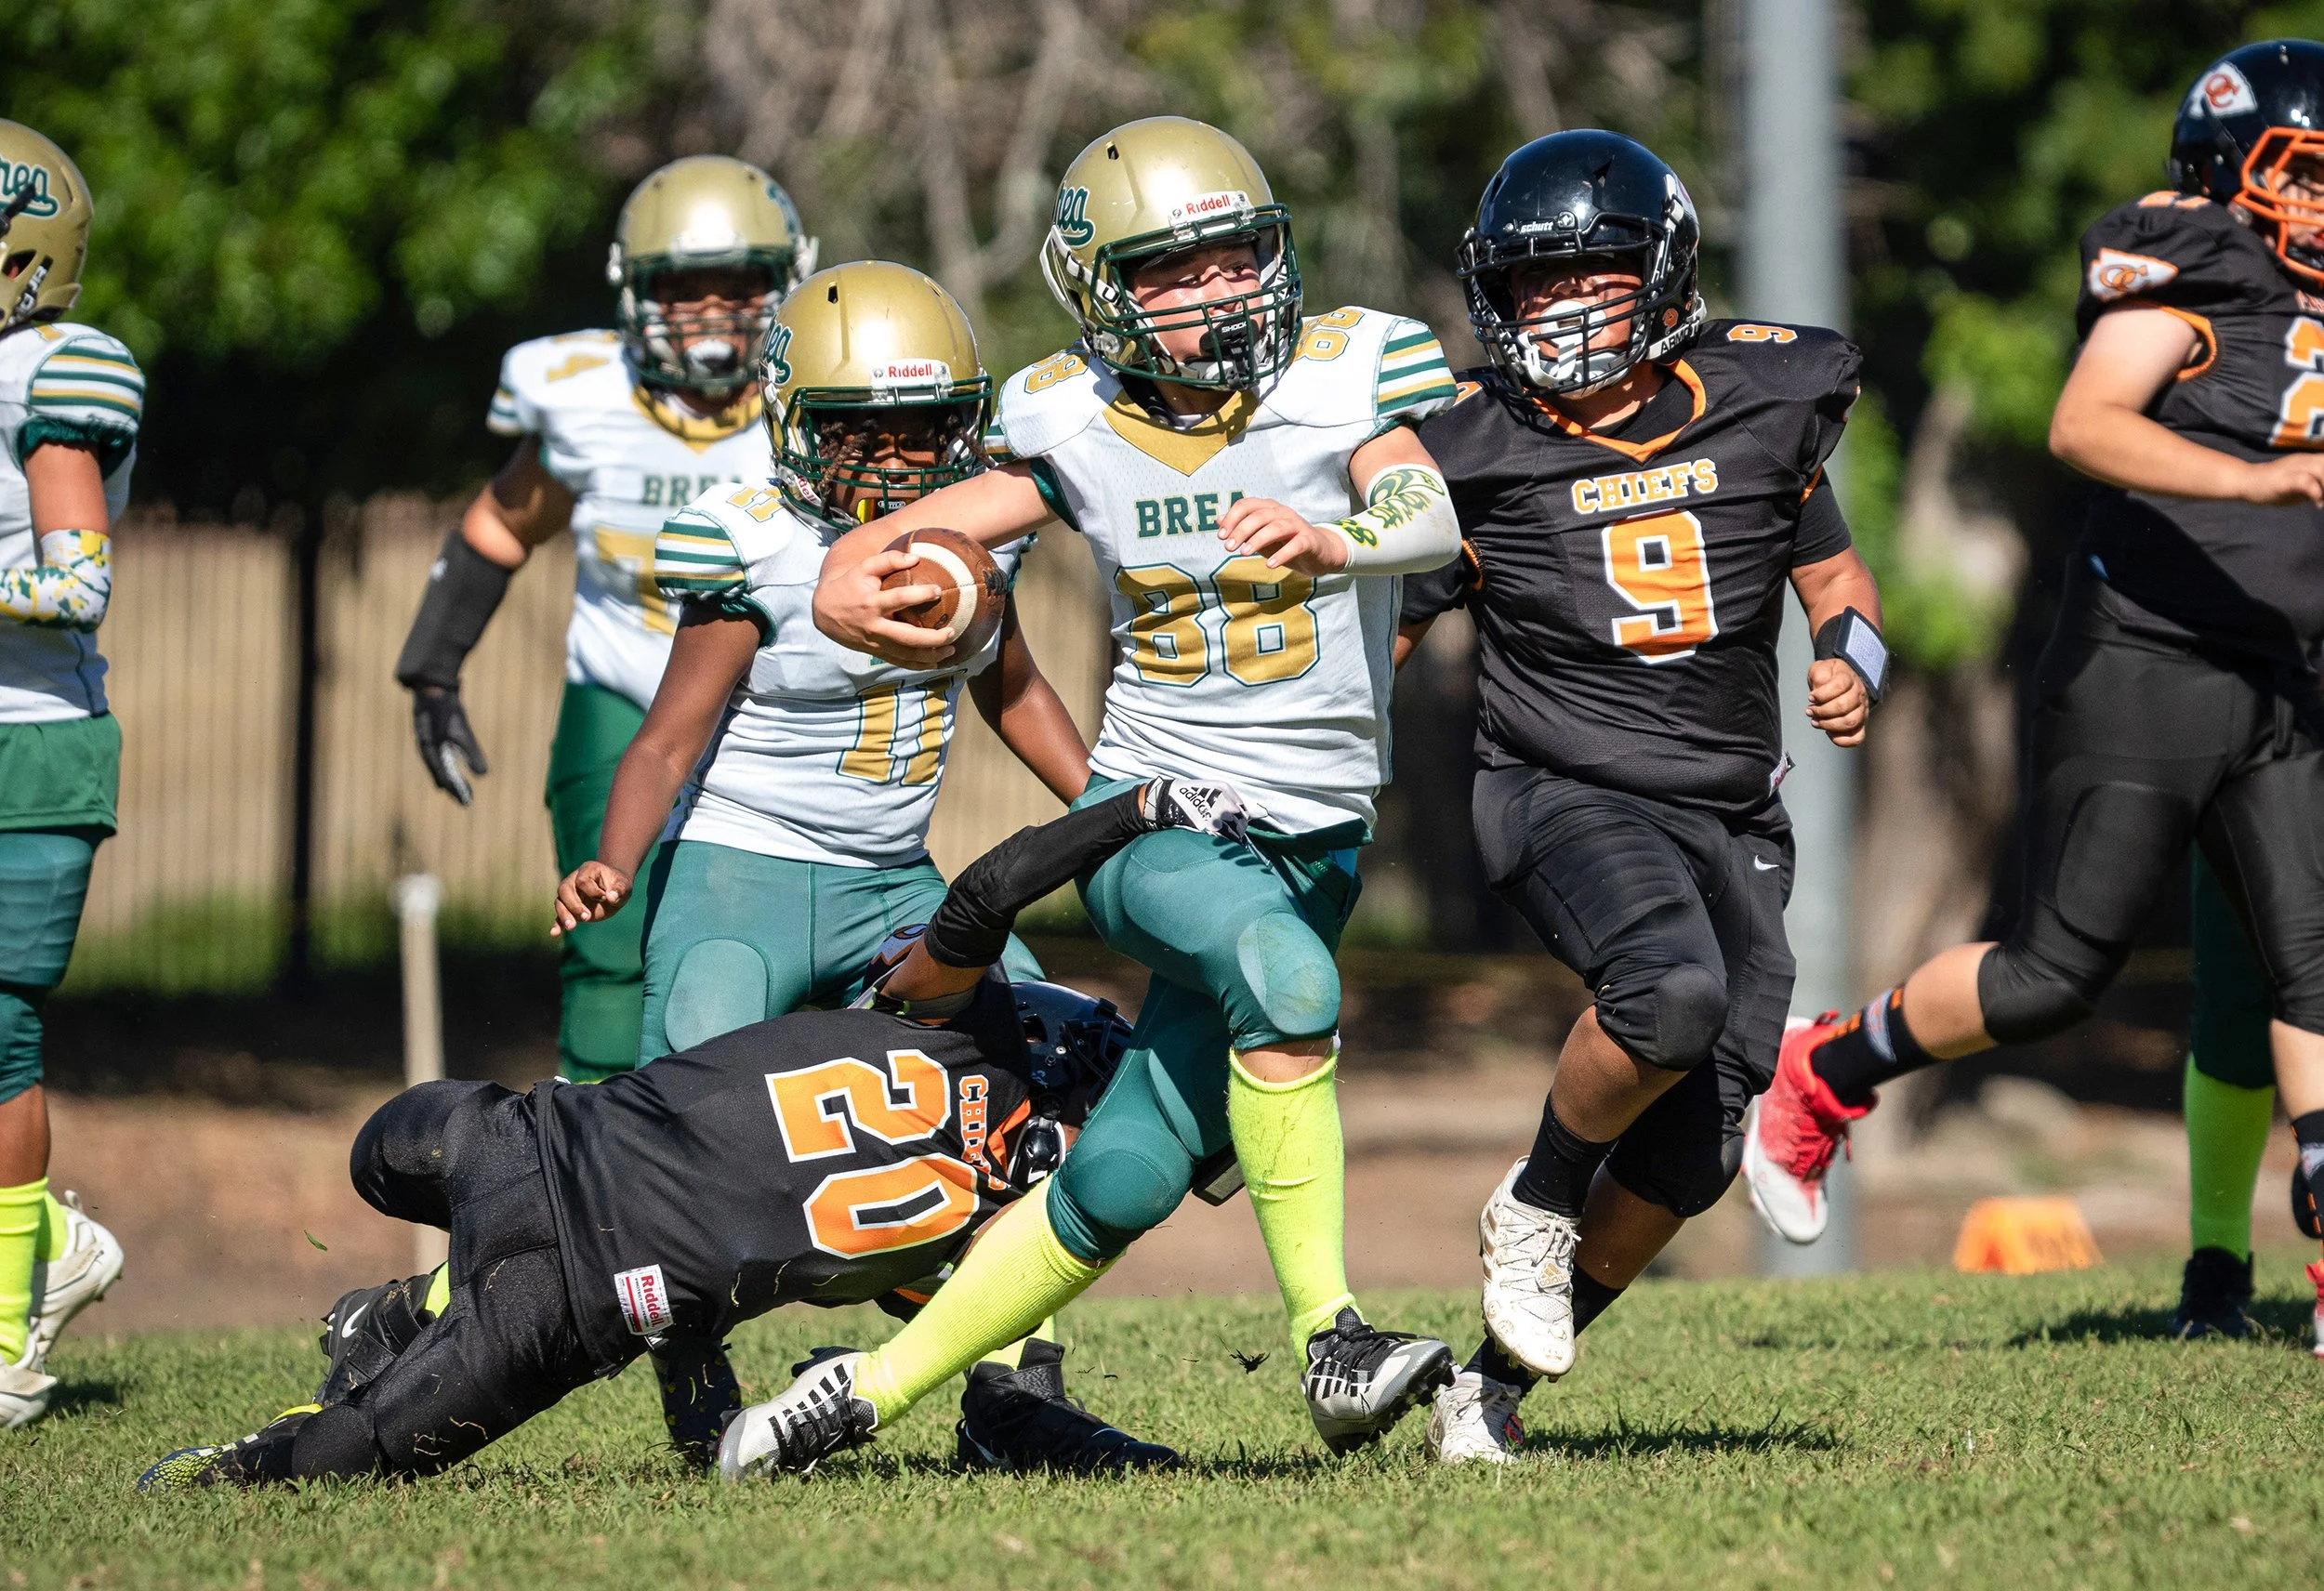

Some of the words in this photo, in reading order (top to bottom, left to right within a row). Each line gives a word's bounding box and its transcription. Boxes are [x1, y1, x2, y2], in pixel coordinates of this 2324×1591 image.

[1186, 194, 1231, 216] Riddell
[1520, 220, 1554, 233] schutt
[1221, 321, 1248, 335] SHOCK
[888, 363, 932, 378] Riddell
[641, 475, 743, 507] BRE
[1572, 458, 1719, 514] CHIEFS
[1602, 507, 1719, 665] 9
[1114, 554, 1321, 689] 88
[836, 668, 968, 787] 11
[1179, 787, 1212, 820] adidas
[764, 1049, 981, 1260] 20
[1538, 1273, 1569, 1287] adidas
[640, 1275, 665, 1328] Riddell
